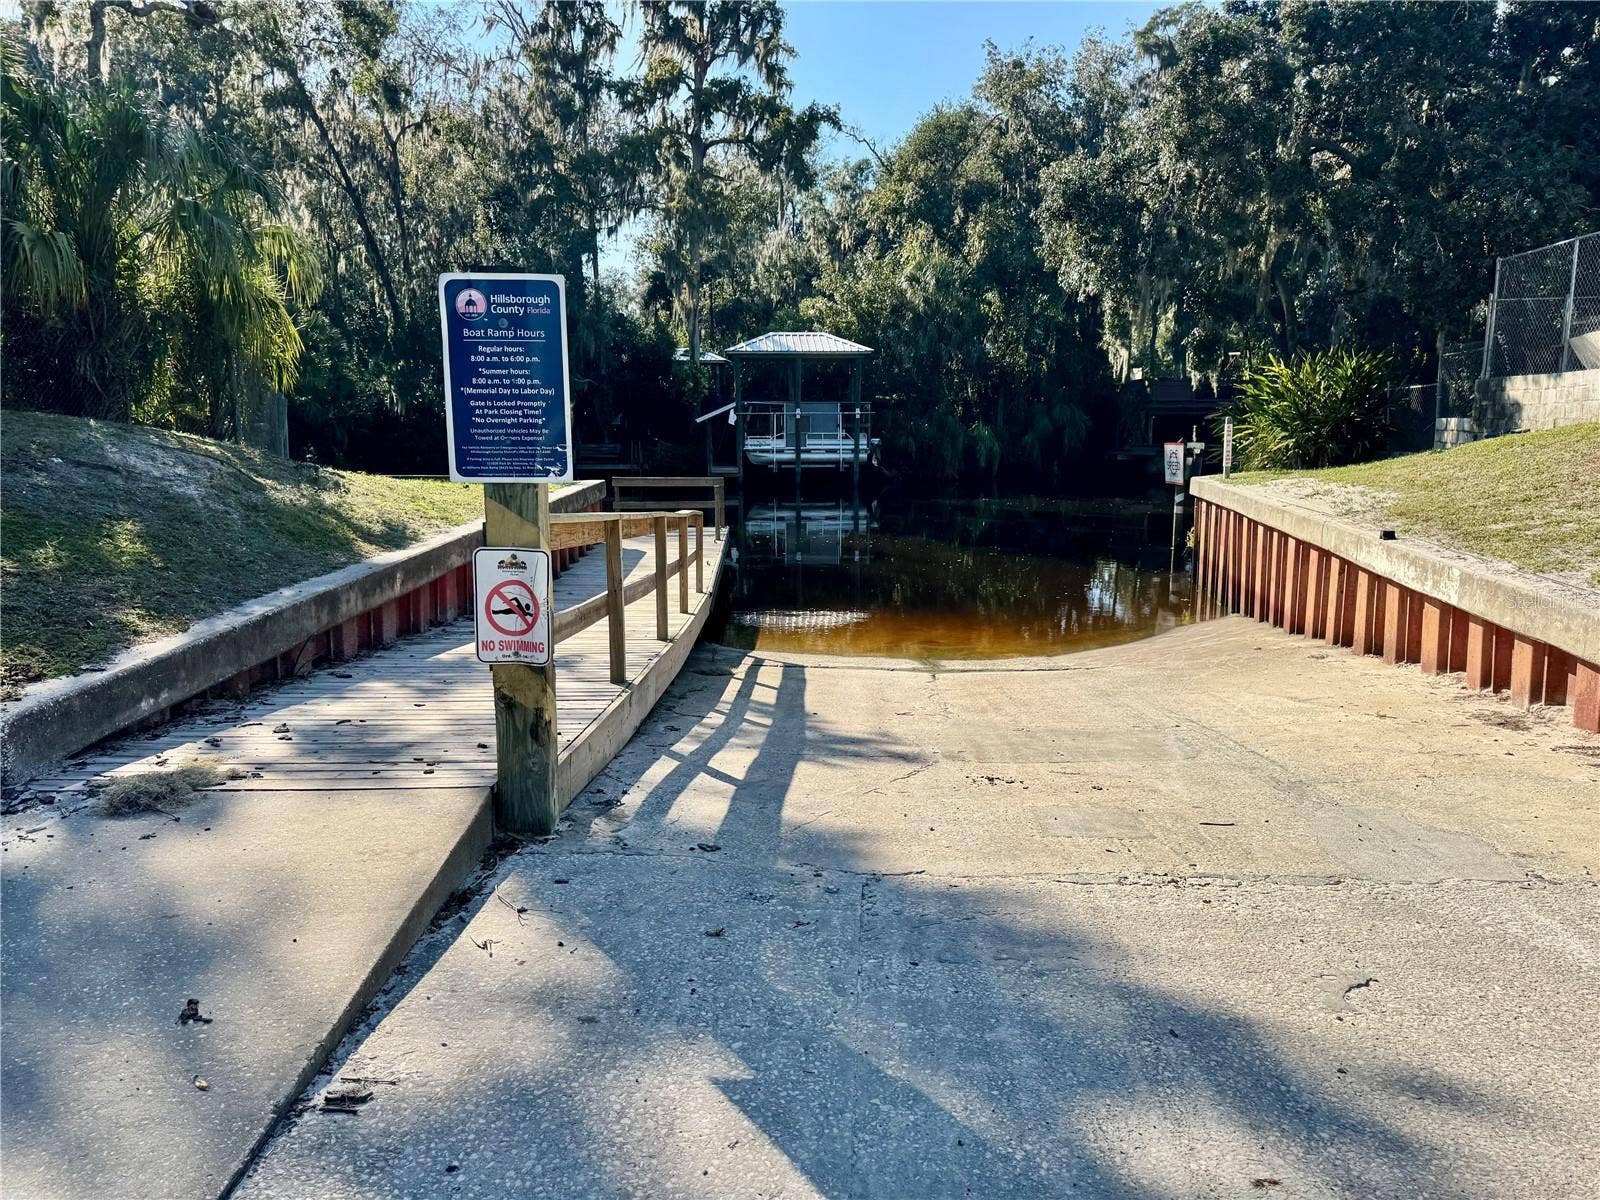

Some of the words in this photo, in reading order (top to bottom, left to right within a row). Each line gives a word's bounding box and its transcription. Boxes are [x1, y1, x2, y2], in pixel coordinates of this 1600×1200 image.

[490, 294, 551, 306] Hillsborough
[490, 304, 525, 316] County
[463, 328, 484, 337] Boat
[487, 328, 515, 339] Ramp
[517, 328, 545, 338] Hours
[478, 345, 503, 354] Regular
[504, 345, 525, 353] hours:
[498, 387, 511, 395] Day
[539, 387, 555, 396] Day)
[516, 400, 546, 408] Promptly
[499, 408, 523, 416] Closing
[485, 417, 518, 425] Overnight
[481, 640, 496, 652] NO
[498, 640, 545, 653] SWIMMING
